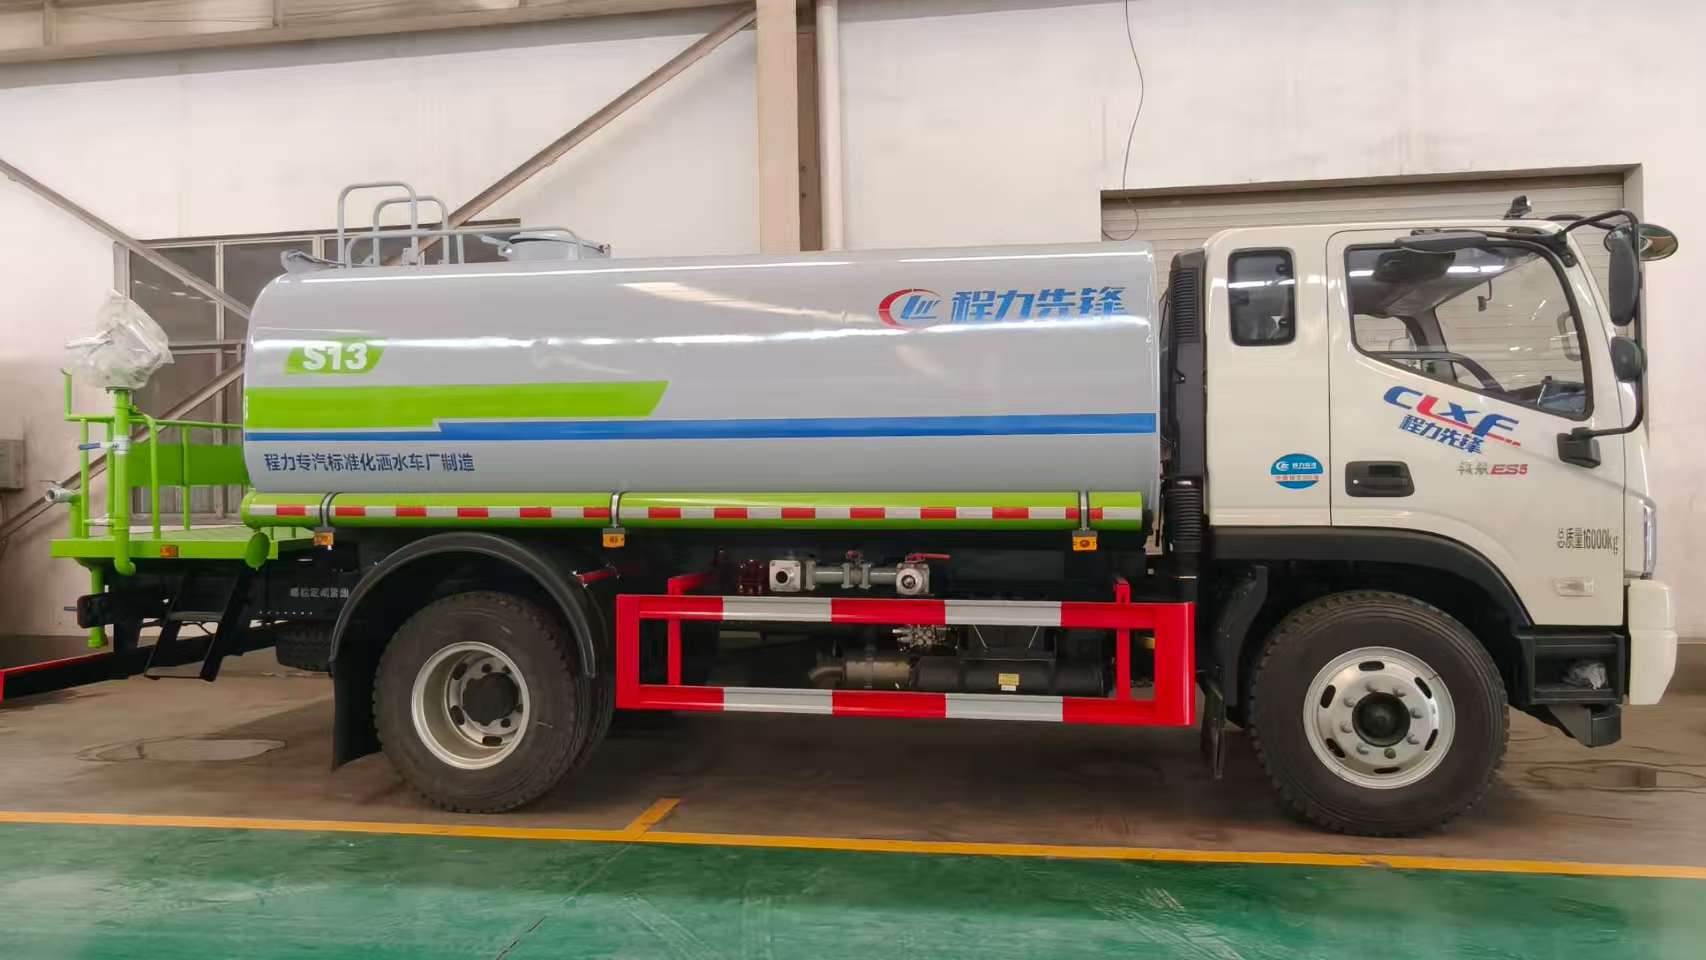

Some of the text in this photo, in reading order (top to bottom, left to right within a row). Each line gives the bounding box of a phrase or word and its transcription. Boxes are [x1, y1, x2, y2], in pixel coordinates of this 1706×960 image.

[951, 286, 1127, 323] 程力先锋
[303, 342, 368, 370] S13
[1383, 385, 1520, 440] CLXF
[1399, 414, 1484, 454] 程力先锋
[264, 453, 475, 472] 程力专汽标准化洒水车厂制造
